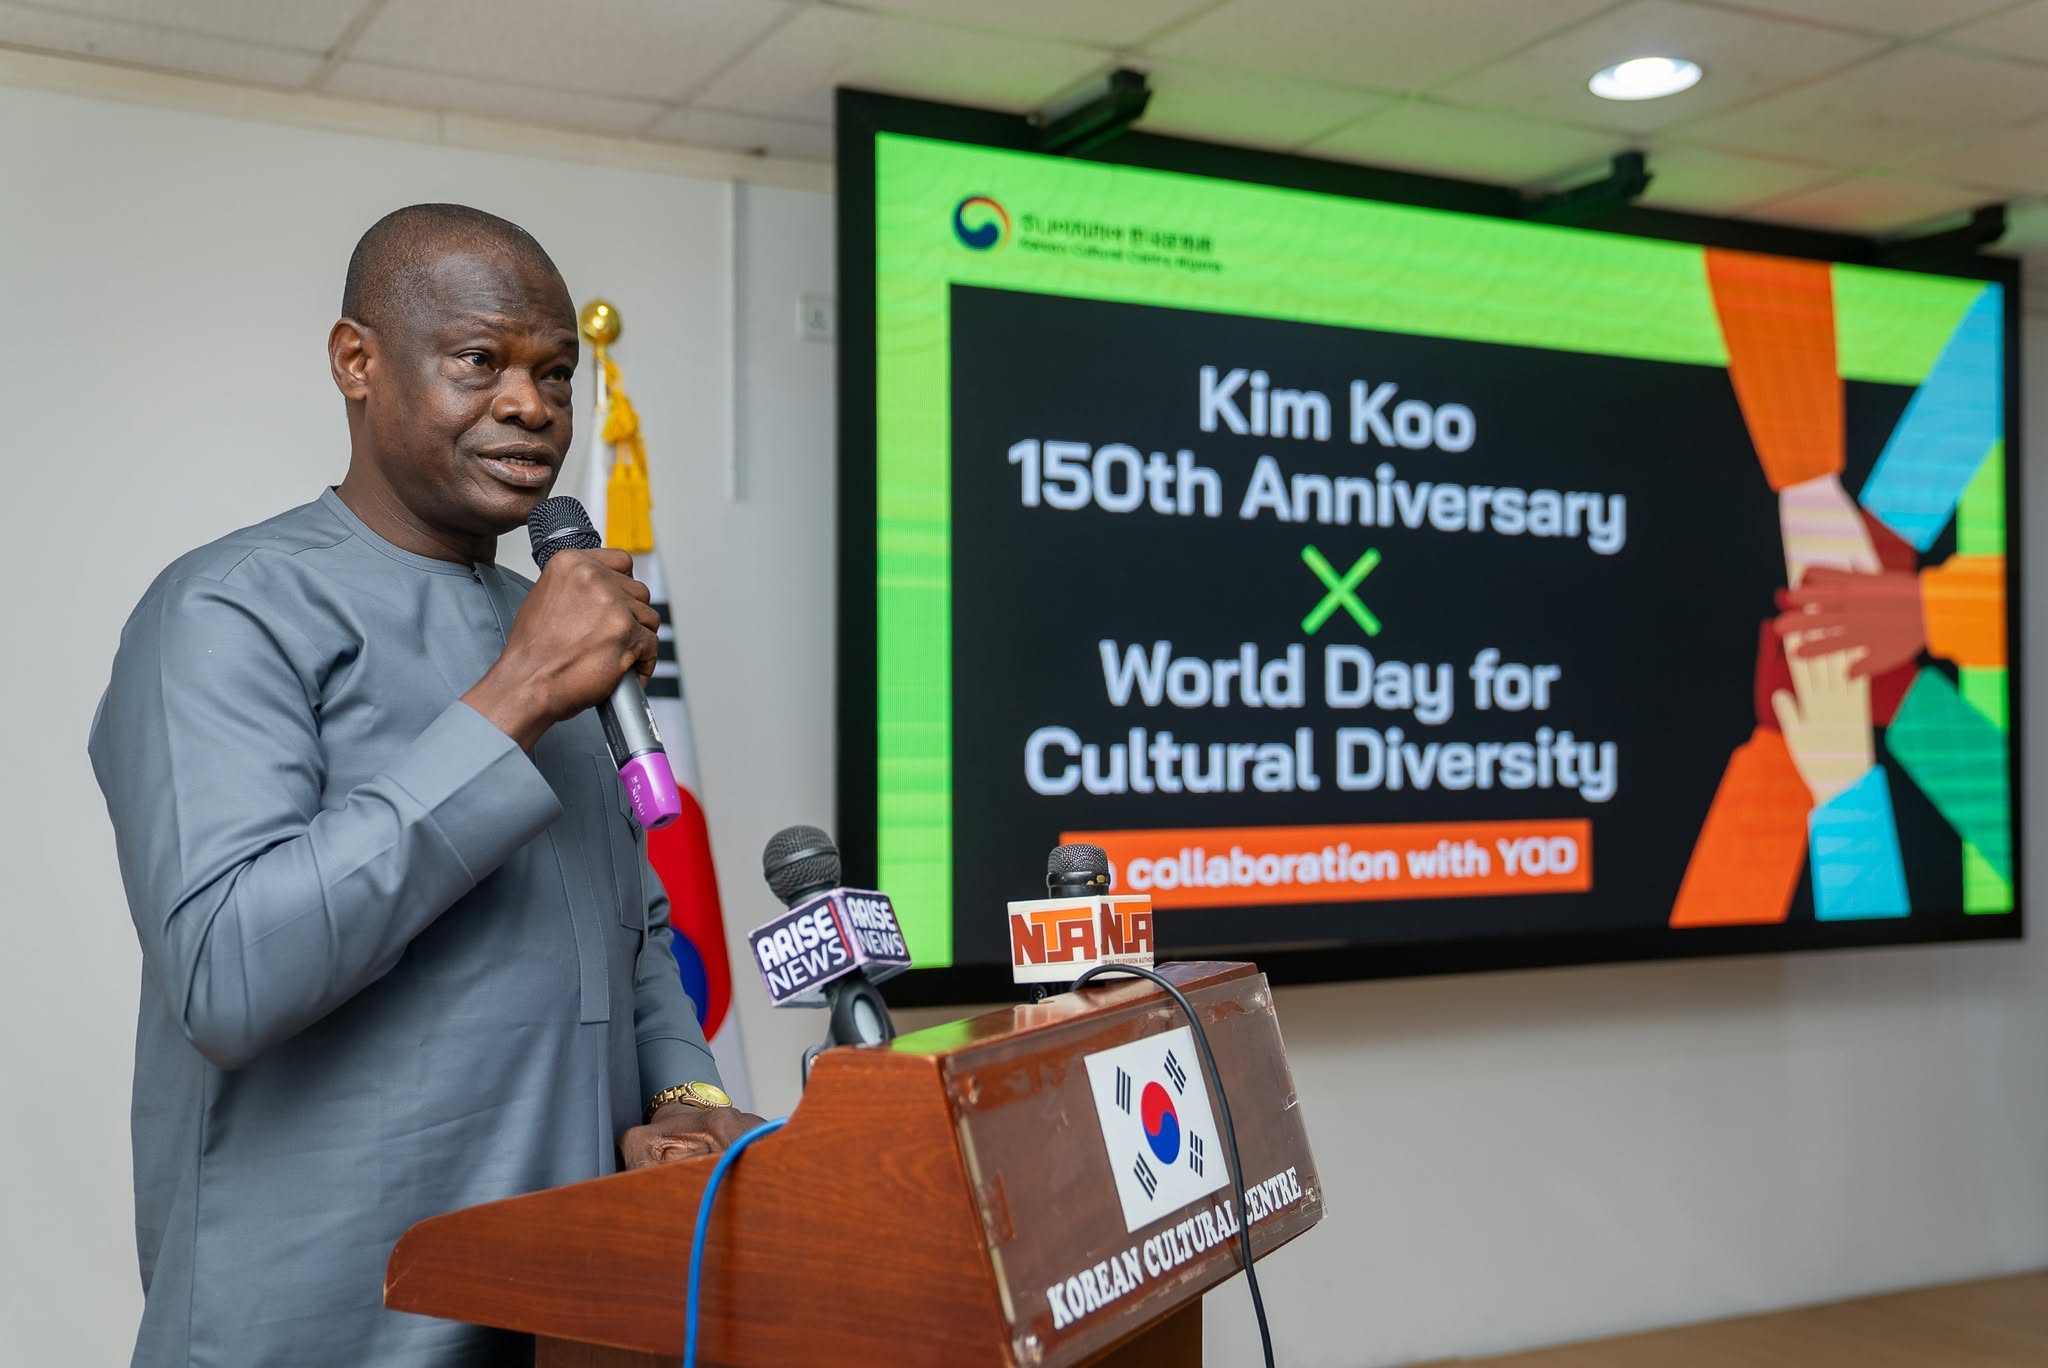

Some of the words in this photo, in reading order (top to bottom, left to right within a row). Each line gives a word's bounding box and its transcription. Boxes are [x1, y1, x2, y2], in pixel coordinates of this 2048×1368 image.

[1200, 366, 1331, 441] Kim
[1350, 380, 1475, 452] Koo
[1008, 439, 1221, 517] 150th
[1240, 456, 1626, 555] Anniversary
[1099, 640, 1304, 708] World
[1325, 645, 1453, 725] Day
[1469, 649, 1560, 710] for
[1024, 726, 1319, 796] Cultural
[1336, 727, 1617, 802] Diversity
[1126, 843, 1400, 891] collaboration
[1405, 838, 1491, 880] with
[1496, 835, 1579, 877] YOD
[757, 905, 837, 971] ARISE
[846, 897, 896, 931] ARISE
[856, 929, 905, 956] NEWS
[1010, 907, 1097, 966] NTA
[1100, 901, 1153, 955] NTA
[767, 937, 847, 996] NEWS
[1046, 1246, 1144, 1330] KOREAN
[1143, 1200, 1240, 1278] CULTURAL
